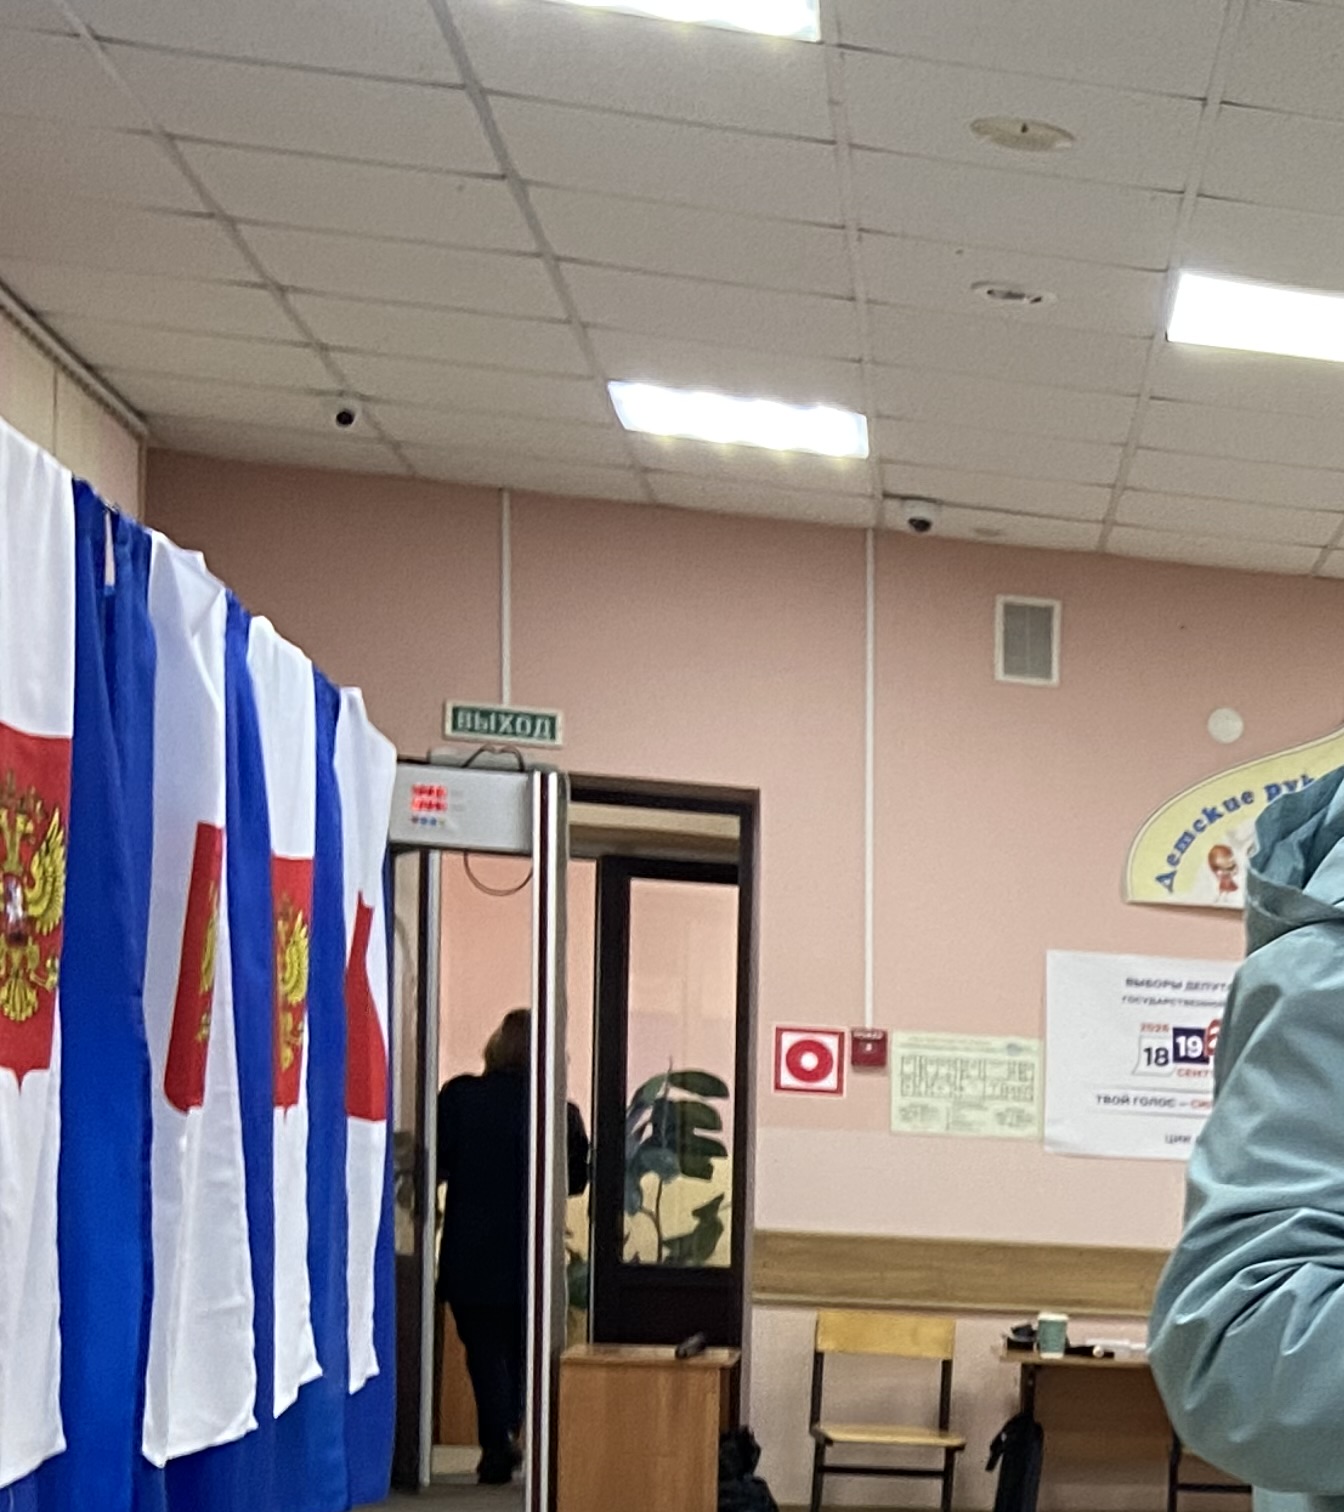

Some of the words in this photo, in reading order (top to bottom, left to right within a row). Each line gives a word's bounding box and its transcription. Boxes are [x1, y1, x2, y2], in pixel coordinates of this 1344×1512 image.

[456, 709, 551, 740] ВЫХОД
[1125, 976, 1183, 990] ВЫБОРЫ
[1184, 980, 1230, 992] ДЕПУТ
[1143, 1046, 1169, 1067] 18
[1175, 1035, 1204, 1059] 19
[1176, 1067, 1211, 1078] СЕНТ
[1096, 1093, 1130, 1105] ТВОЙ
[1132, 1096, 1177, 1108] ГОЛОС
